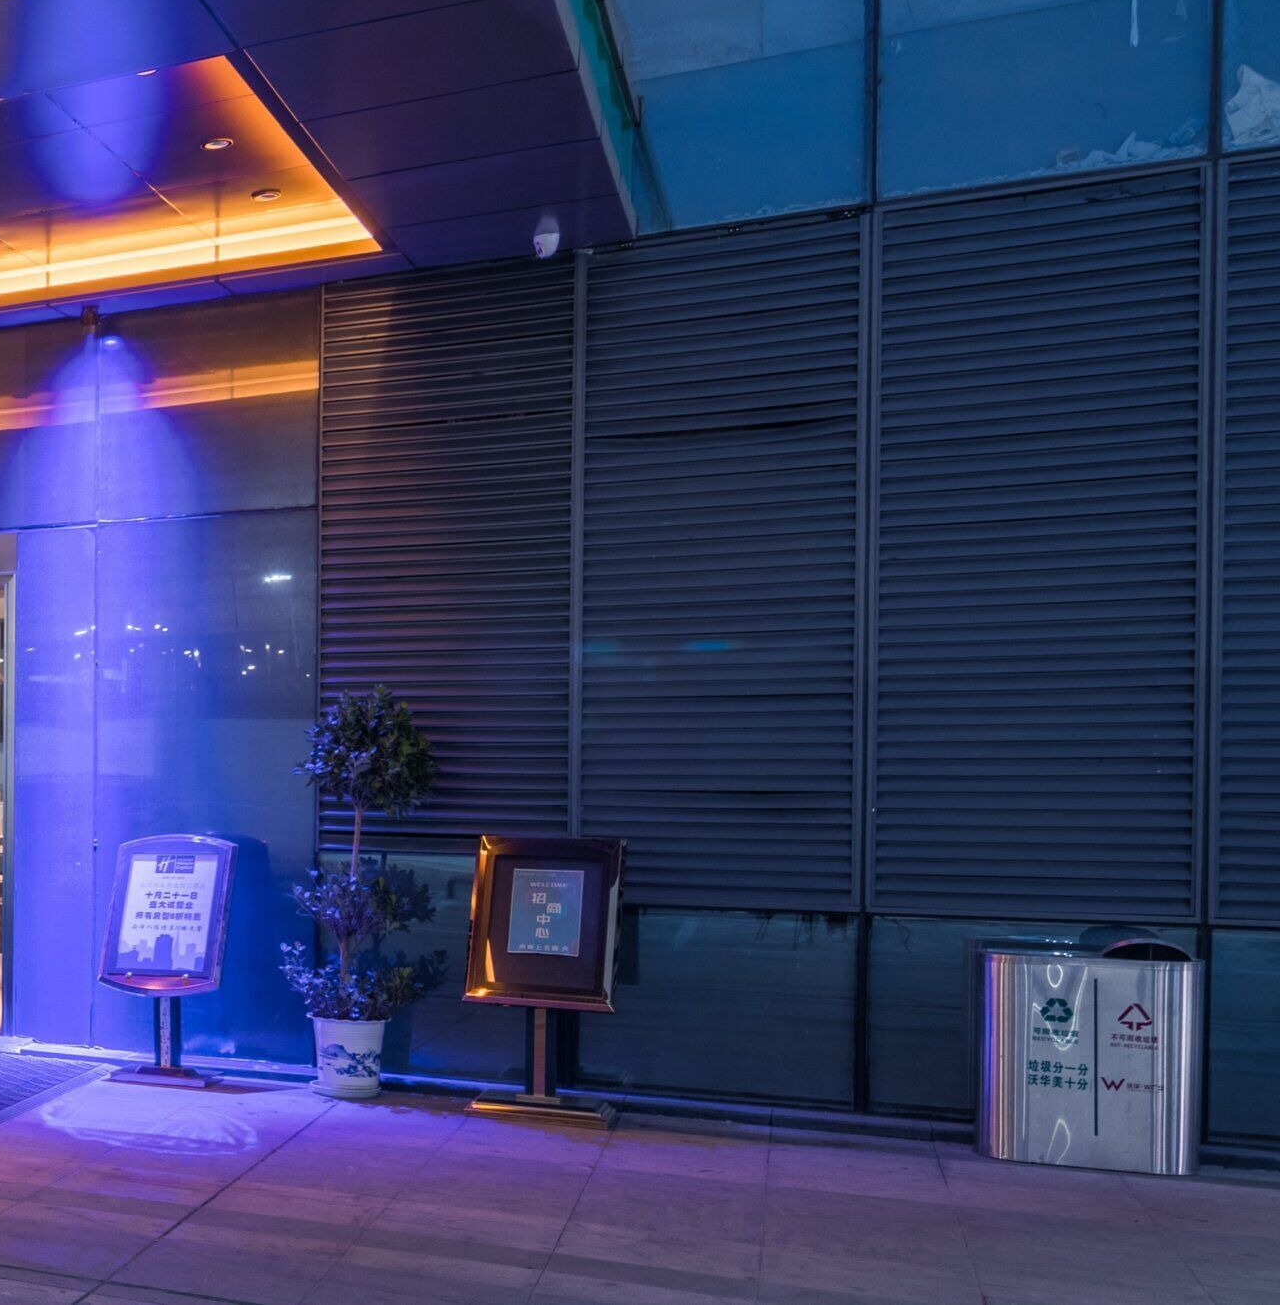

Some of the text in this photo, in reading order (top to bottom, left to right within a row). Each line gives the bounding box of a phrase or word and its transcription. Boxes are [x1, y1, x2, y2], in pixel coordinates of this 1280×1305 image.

[145, 891, 198, 900] 十月二十一日
[531, 892, 561, 938] 招商中心
[1033, 1027, 1079, 1038] 可回收垃圾
[1110, 1034, 1158, 1044] 不可回收垃圾
[1028, 1060, 1088, 1076] 垃圾分一分
[1027, 1074, 1088, 1090] 沃华美十分
